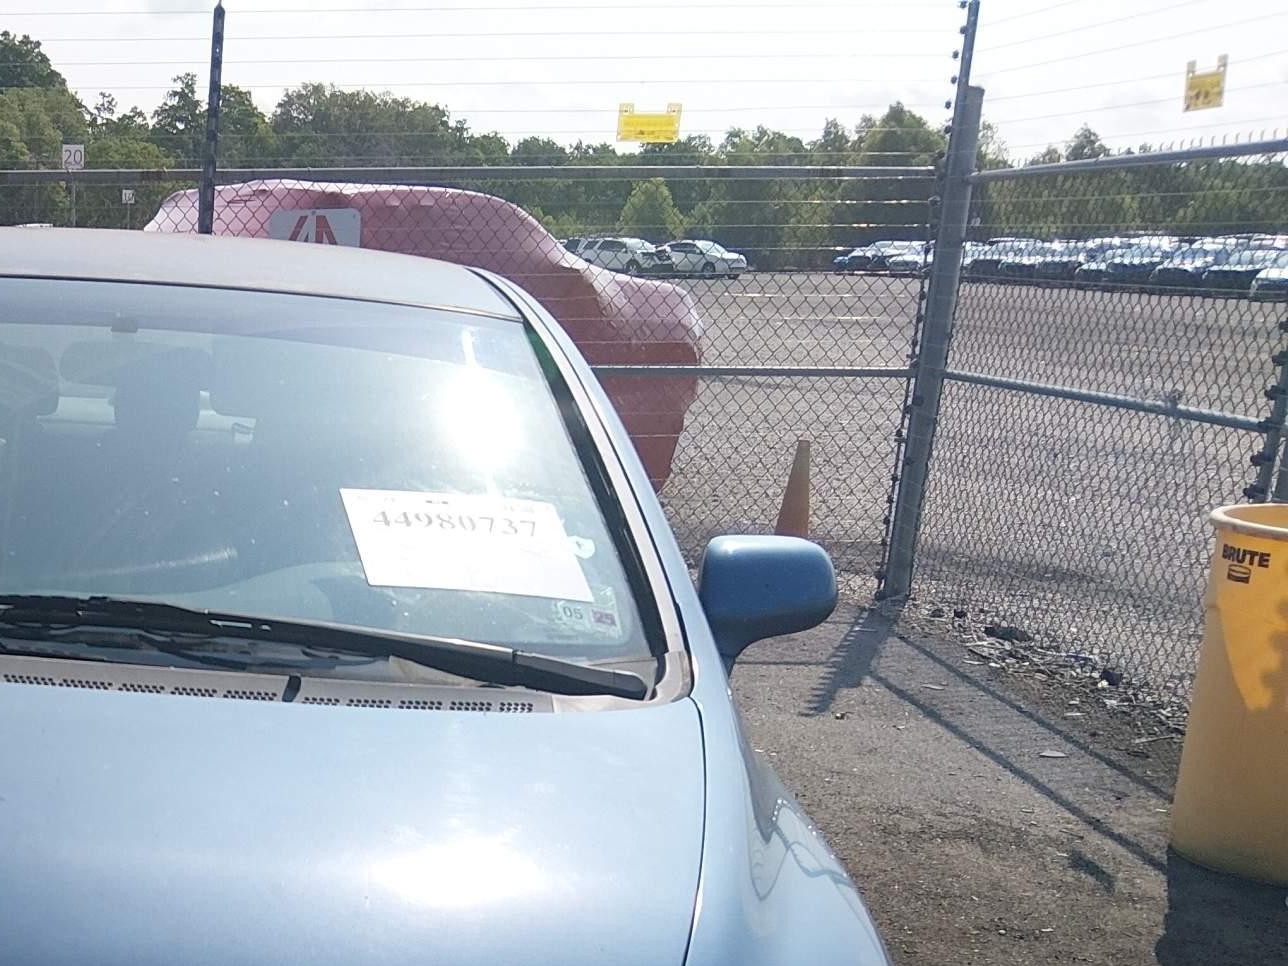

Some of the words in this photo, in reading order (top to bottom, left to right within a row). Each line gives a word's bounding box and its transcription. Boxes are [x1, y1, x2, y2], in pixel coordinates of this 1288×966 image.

[64, 149, 83, 165] 20
[372, 510, 536, 537] 44980737
[562, 606, 584, 620] 05
